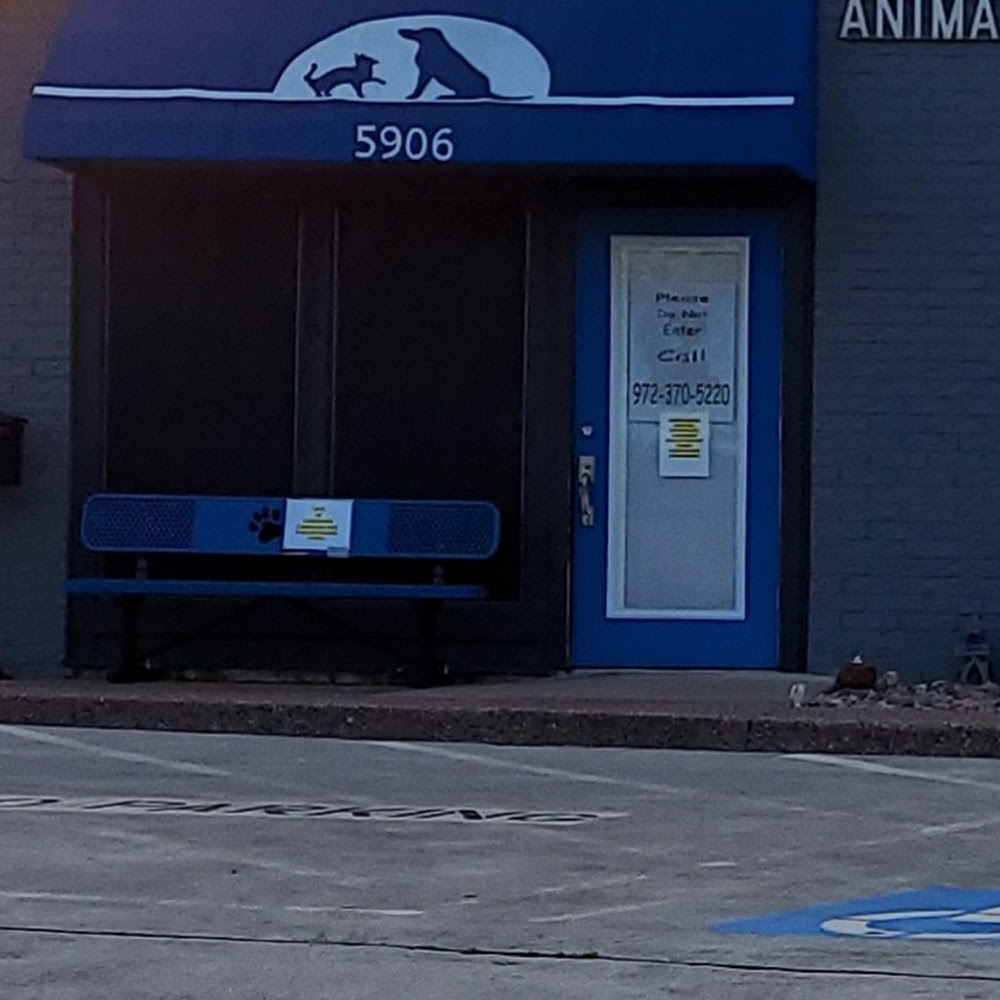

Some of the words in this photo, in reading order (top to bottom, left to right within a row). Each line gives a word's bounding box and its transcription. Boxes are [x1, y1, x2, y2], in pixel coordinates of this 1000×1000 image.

[354, 124, 454, 161] 5906
[662, 323, 702, 336] Enter
[657, 348, 706, 363] Call
[632, 382, 731, 405] 972-370-5220
